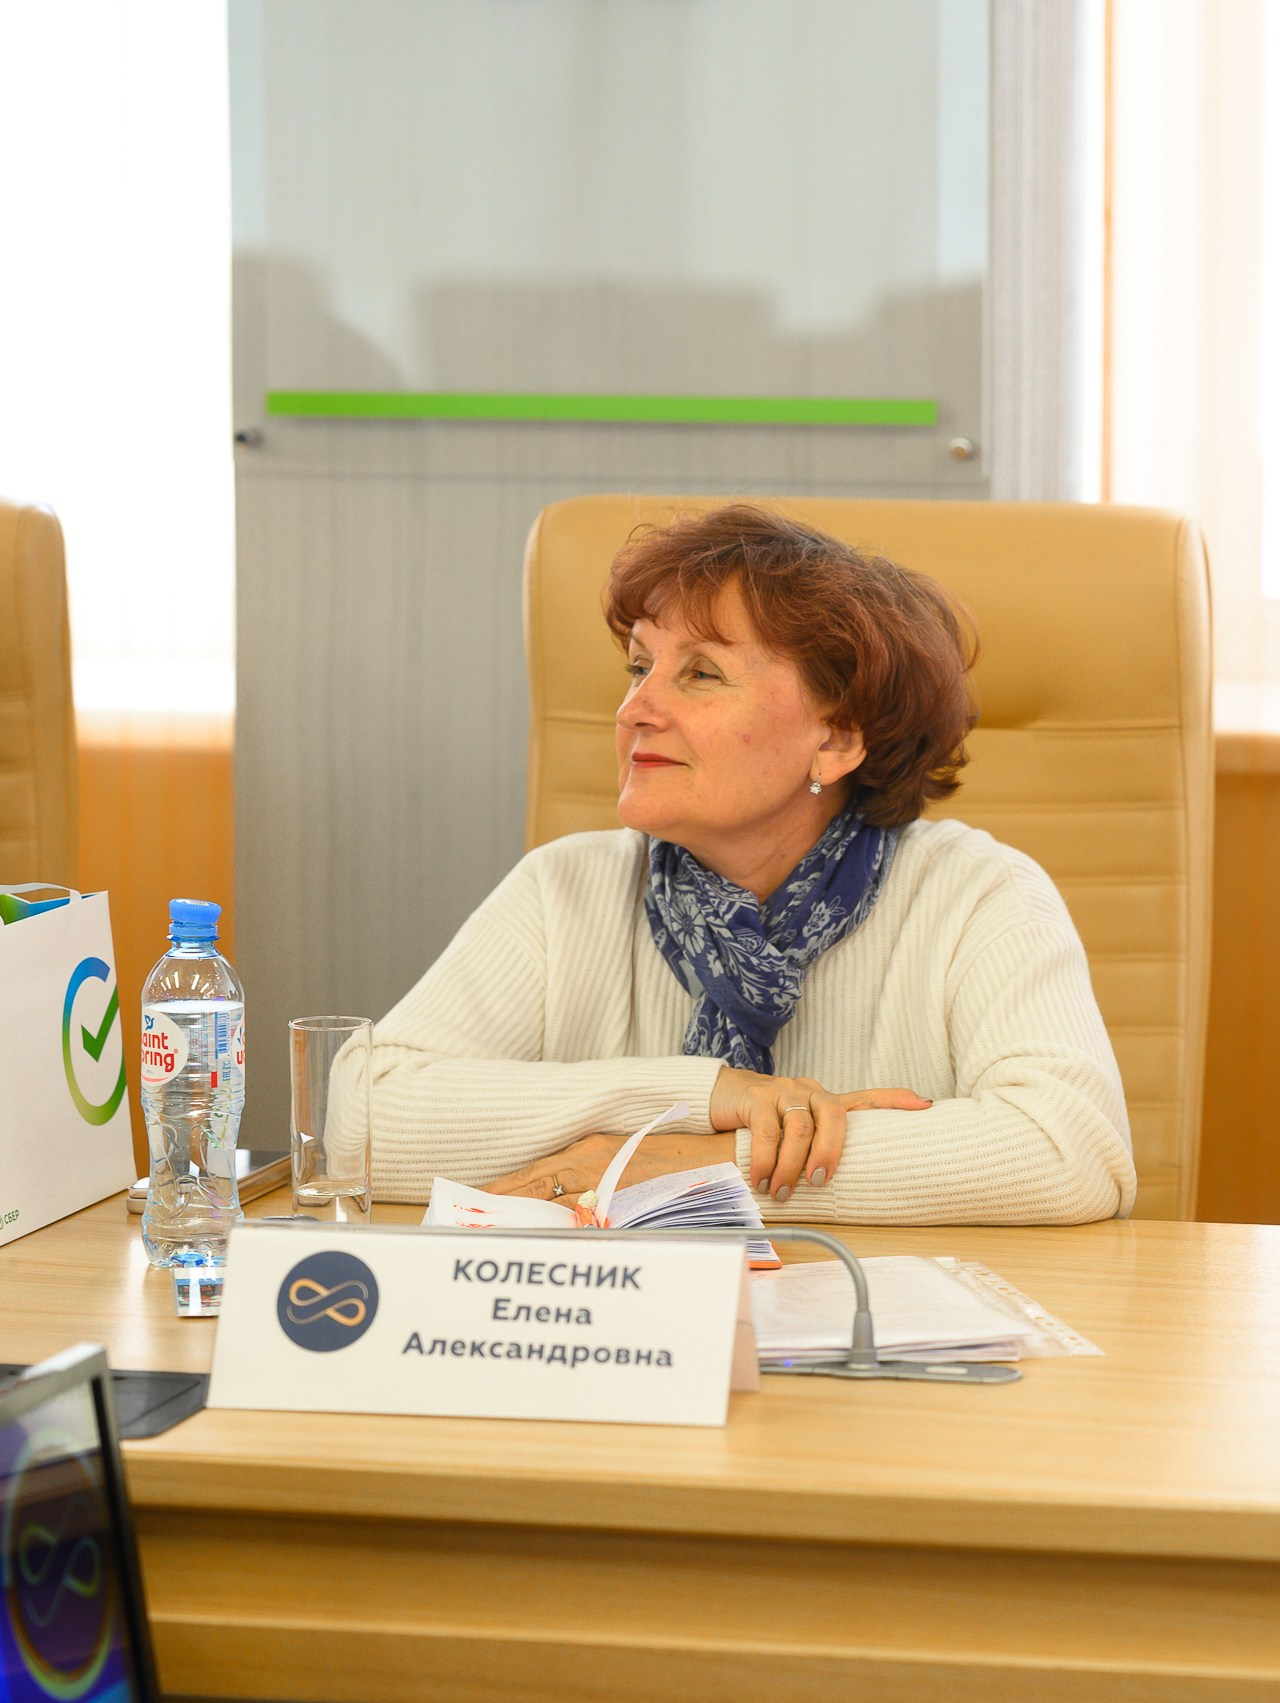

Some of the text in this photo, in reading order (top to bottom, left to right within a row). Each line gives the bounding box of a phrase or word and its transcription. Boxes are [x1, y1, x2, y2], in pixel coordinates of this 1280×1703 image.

[142, 1032, 169, 1050] aint
[141, 1048, 175, 1073] ring
[453, 1259, 642, 1289] КОЛЕСНИК
[492, 1298, 593, 1324] Елена
[402, 1331, 673, 1368] Александровна
